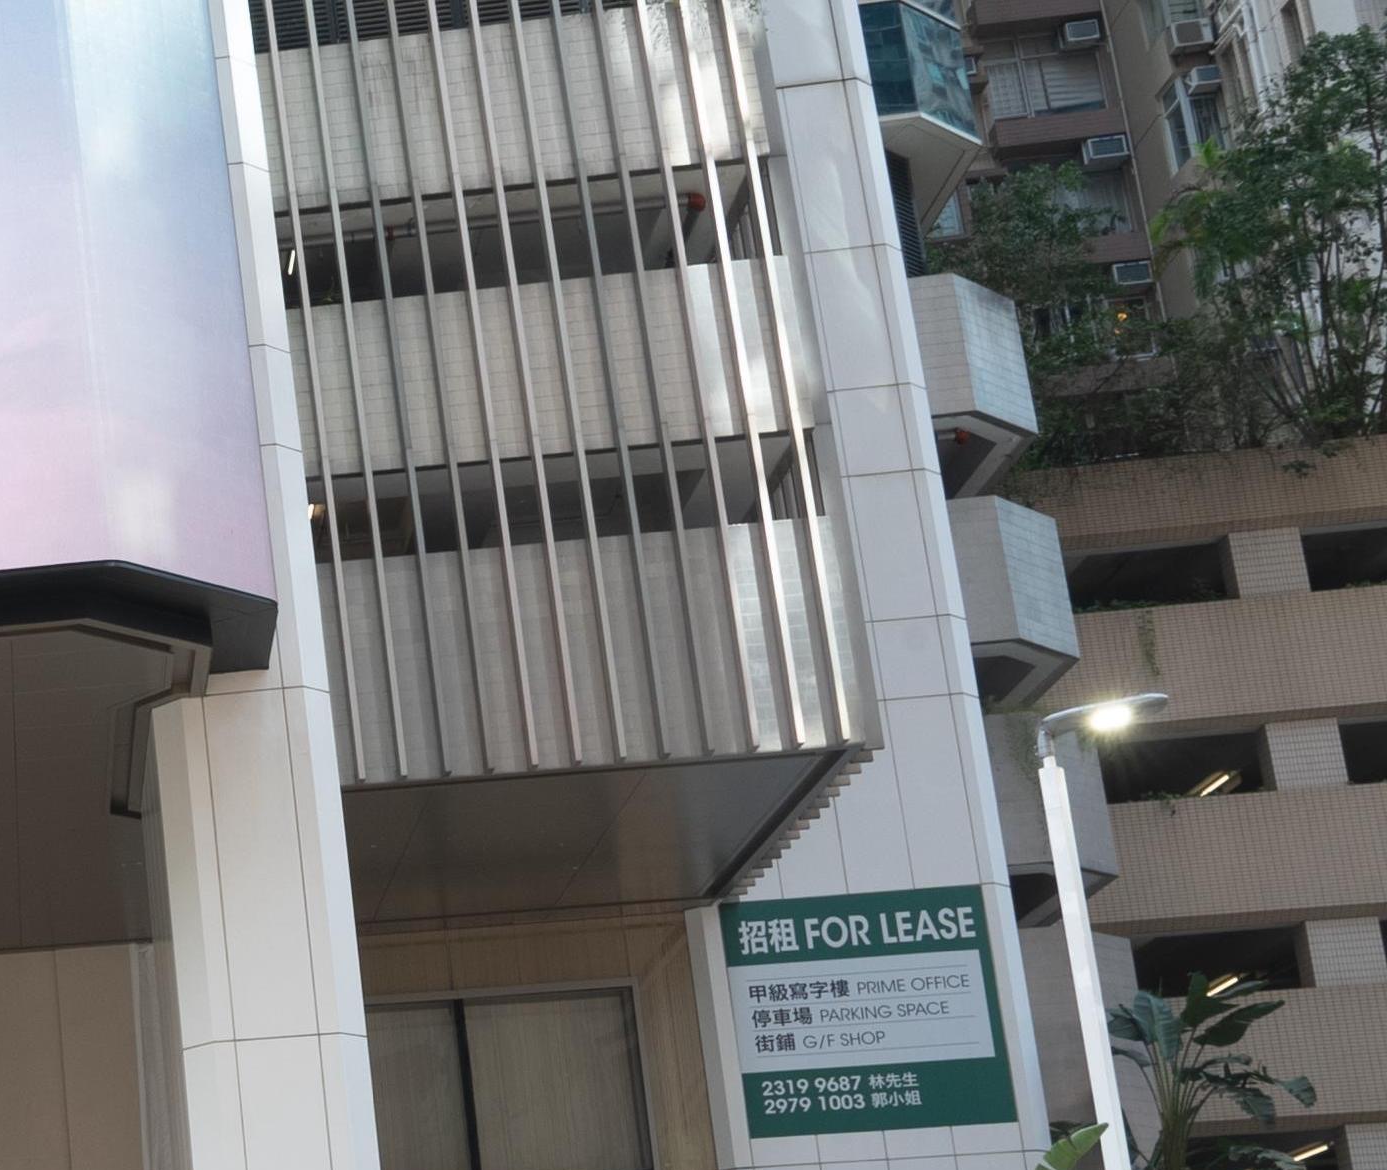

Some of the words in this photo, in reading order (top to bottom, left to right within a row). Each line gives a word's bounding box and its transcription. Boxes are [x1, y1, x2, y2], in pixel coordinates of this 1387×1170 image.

[738, 917, 800, 955] 招租
[804, 915, 871, 949] FOR
[879, 906, 976, 944] LEASE
[748, 979, 850, 1004] 甲級寫字樓
[856, 979, 906, 995] PRIME
[910, 974, 971, 992] OFFICE
[751, 1006, 813, 1029] 停車場
[819, 1004, 892, 1023] PARKING
[897, 1000, 950, 1018] SPACE
[755, 1033, 796, 1053] 街鋪
[802, 1034, 835, 1050] G/F
[840, 1030, 886, 1047] SHOP
[761, 1078, 809, 1097] 2319
[814, 1075, 862, 1094] 9687
[868, 1072, 920, 1090] 林先生
[764, 1097, 812, 1115] 2979
[818, 1093, 865, 1112] 1003
